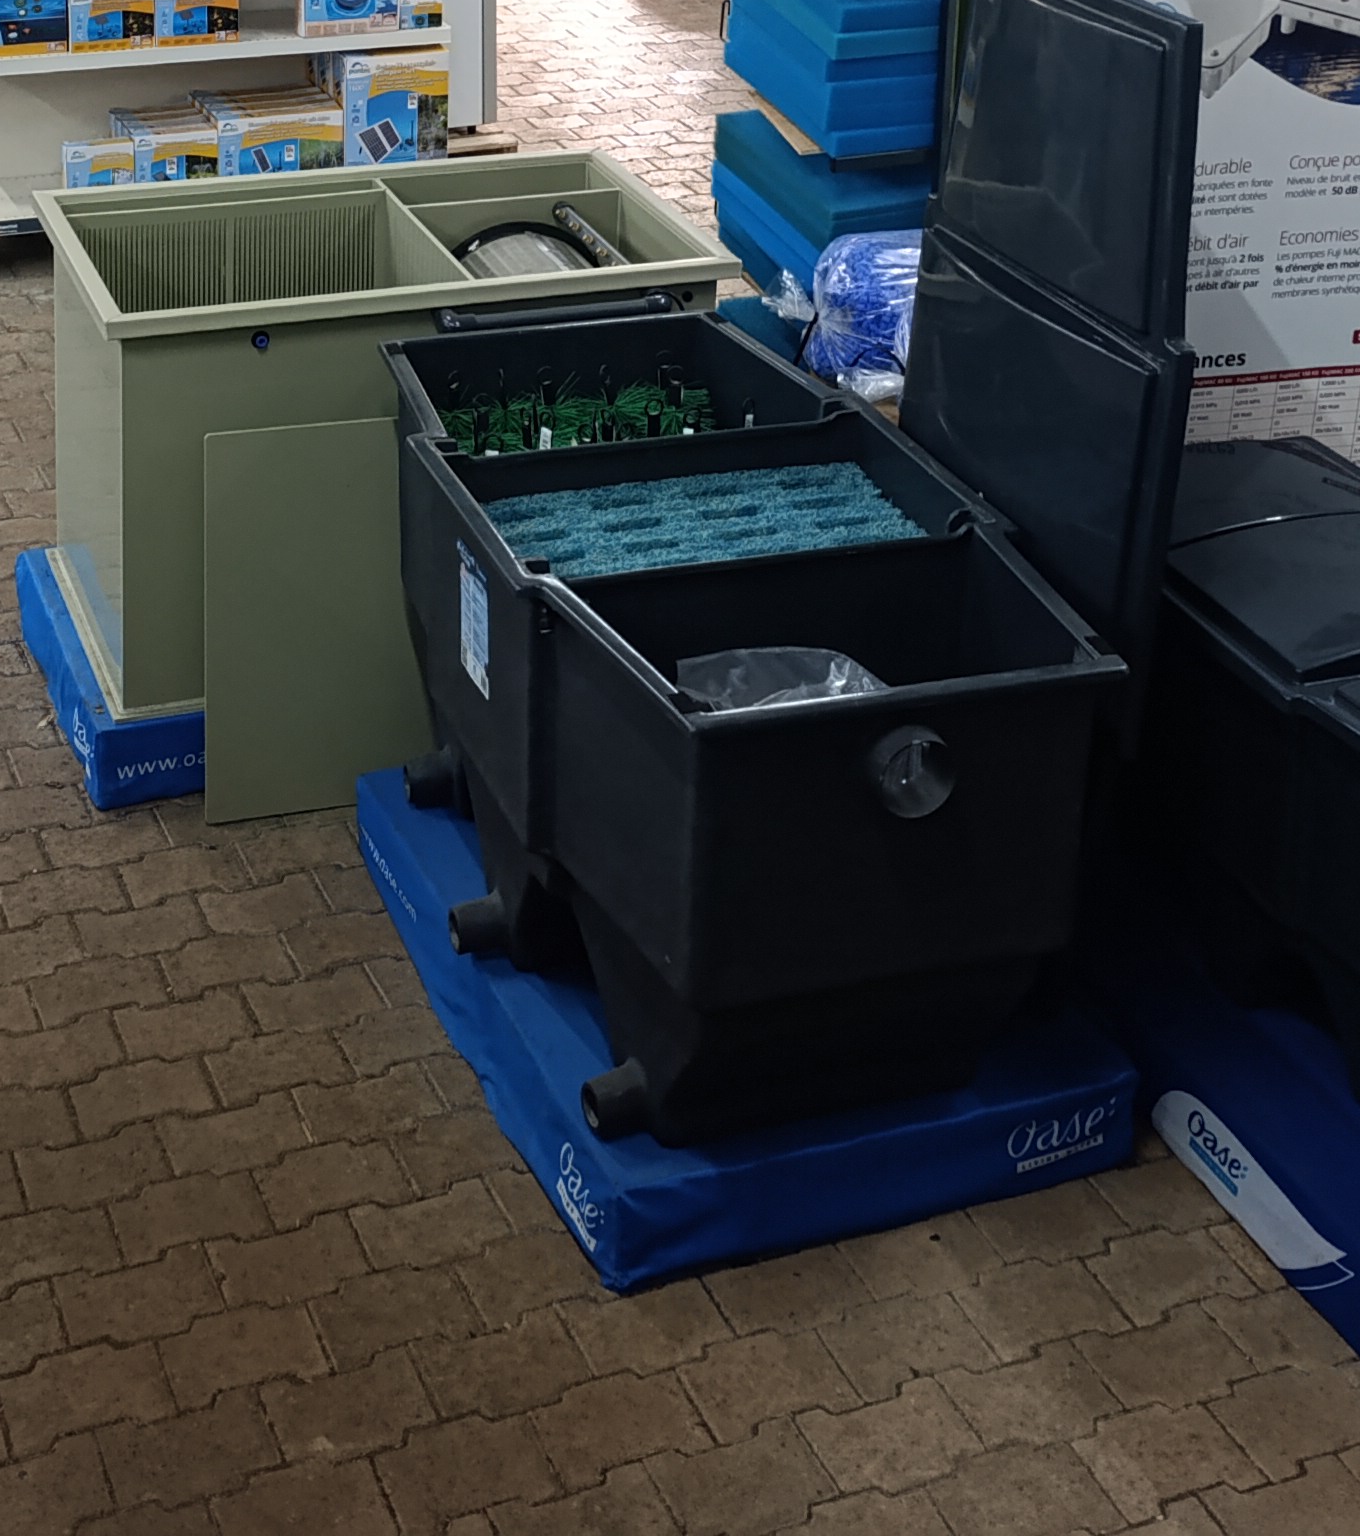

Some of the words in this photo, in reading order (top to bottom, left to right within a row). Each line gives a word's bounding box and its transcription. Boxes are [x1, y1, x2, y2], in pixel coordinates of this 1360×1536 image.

[1194, 156, 1253, 177] durable
[1290, 154, 1340, 172] Conçue
[1250, 178, 1274, 188] fonte
[1286, 175, 1315, 185] Niveau
[1317, 173, 1328, 184] de
[1330, 172, 1351, 183] bruit
[1217, 193, 1237, 204] sont
[1238, 192, 1268, 202] dotées
[1284, 186, 1317, 199] modèle
[1318, 187, 1328, 197] et
[1331, 186, 1343, 196] 50
[1344, 185, 1358, 195] dB
[1216, 232, 1249, 250] d'air
[1279, 226, 1360, 246] Economies
[1239, 253, 1246, 263] 2
[1247, 252, 1265, 263] fois
[1276, 252, 1290, 261] Les
[1291, 250, 1326, 263] pompes
[1225, 266, 1261, 277] d'autres
[1274, 265, 1283, 274] %
[1285, 261, 1324, 274] d'énergie
[1326, 262, 1338, 270] en
[1194, 281, 1219, 292] débit
[1220, 280, 1241, 291] d'air
[1242, 279, 1260, 290] par
[1273, 277, 1284, 287] de
[1285, 274, 1314, 286] chaleur
[1316, 272, 1346, 283] interne
[1271, 287, 1320, 300] membranes
[360, 824, 417, 924] www.oase.com
[1006, 1104, 1106, 1159] Oase
[1187, 1109, 1242, 1180] Oase
[559, 1141, 599, 1229] Oase
